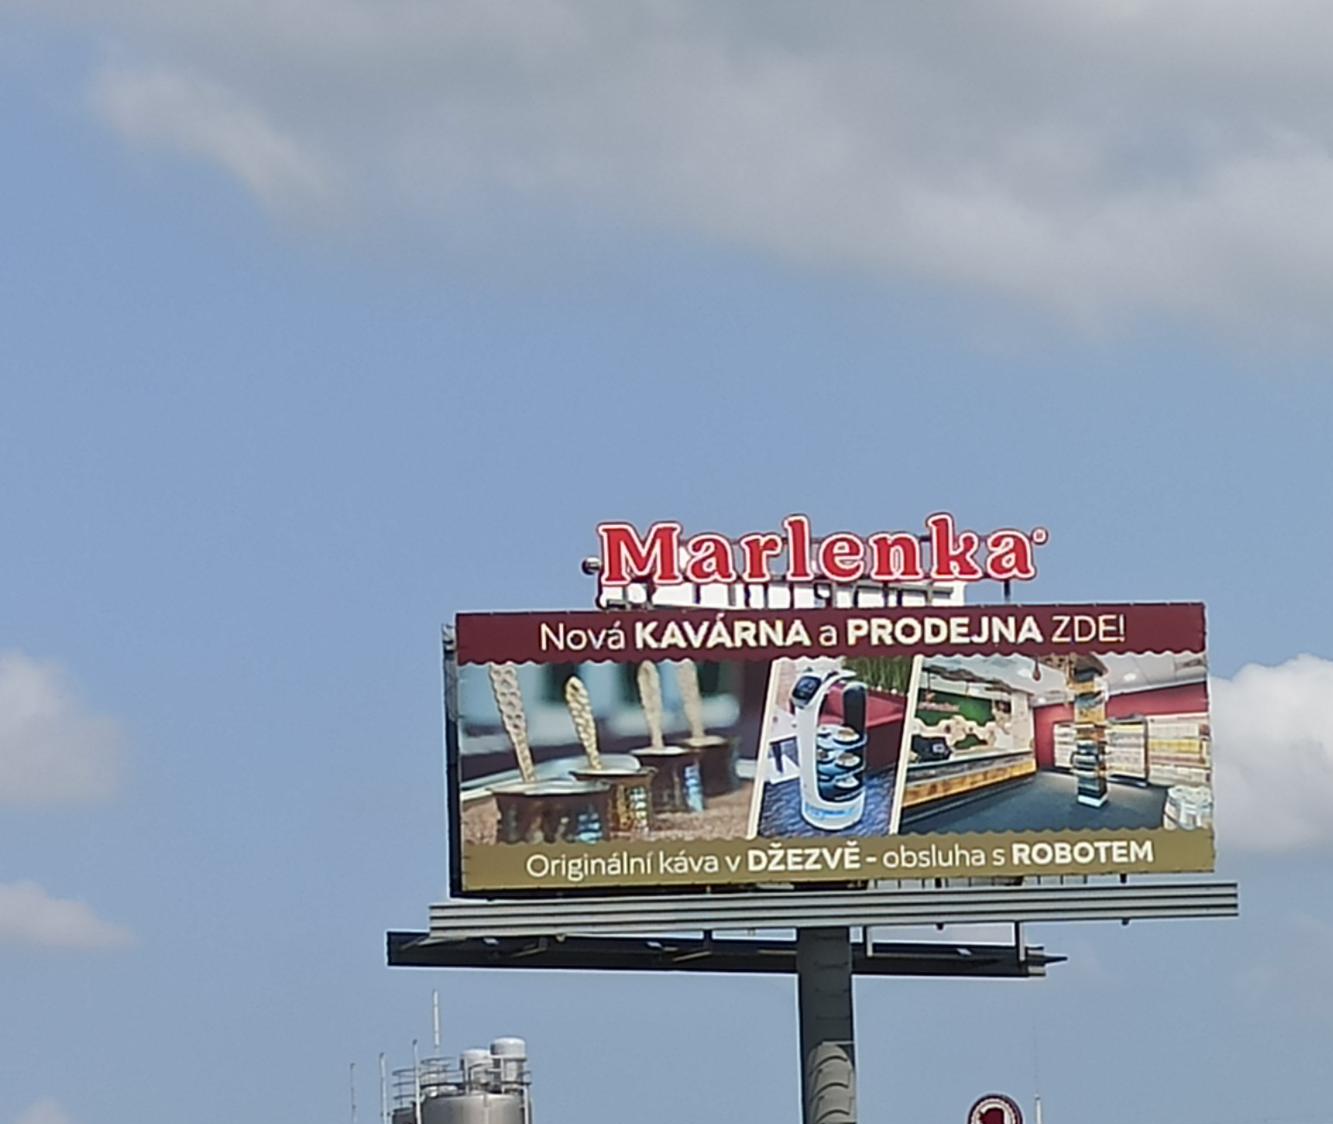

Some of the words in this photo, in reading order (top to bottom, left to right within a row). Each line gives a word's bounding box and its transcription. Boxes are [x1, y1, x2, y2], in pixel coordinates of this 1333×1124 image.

[598, 512, 1035, 586] Marlenka
[540, 621, 626, 652] Nová
[634, 614, 810, 649] KAVÁRNA
[818, 627, 837, 648] a
[847, 614, 1042, 646] PRODEJNA
[1052, 613, 1125, 643] ZDE!
[525, 852, 653, 880] Originální
[659, 850, 719, 875] káva
[726, 856, 743, 872] v
[748, 841, 860, 872] DŽEZVĚ
[883, 844, 986, 869] obsluha
[992, 852, 1005, 868] s
[1012, 840, 1154, 864] ROBOTEM
